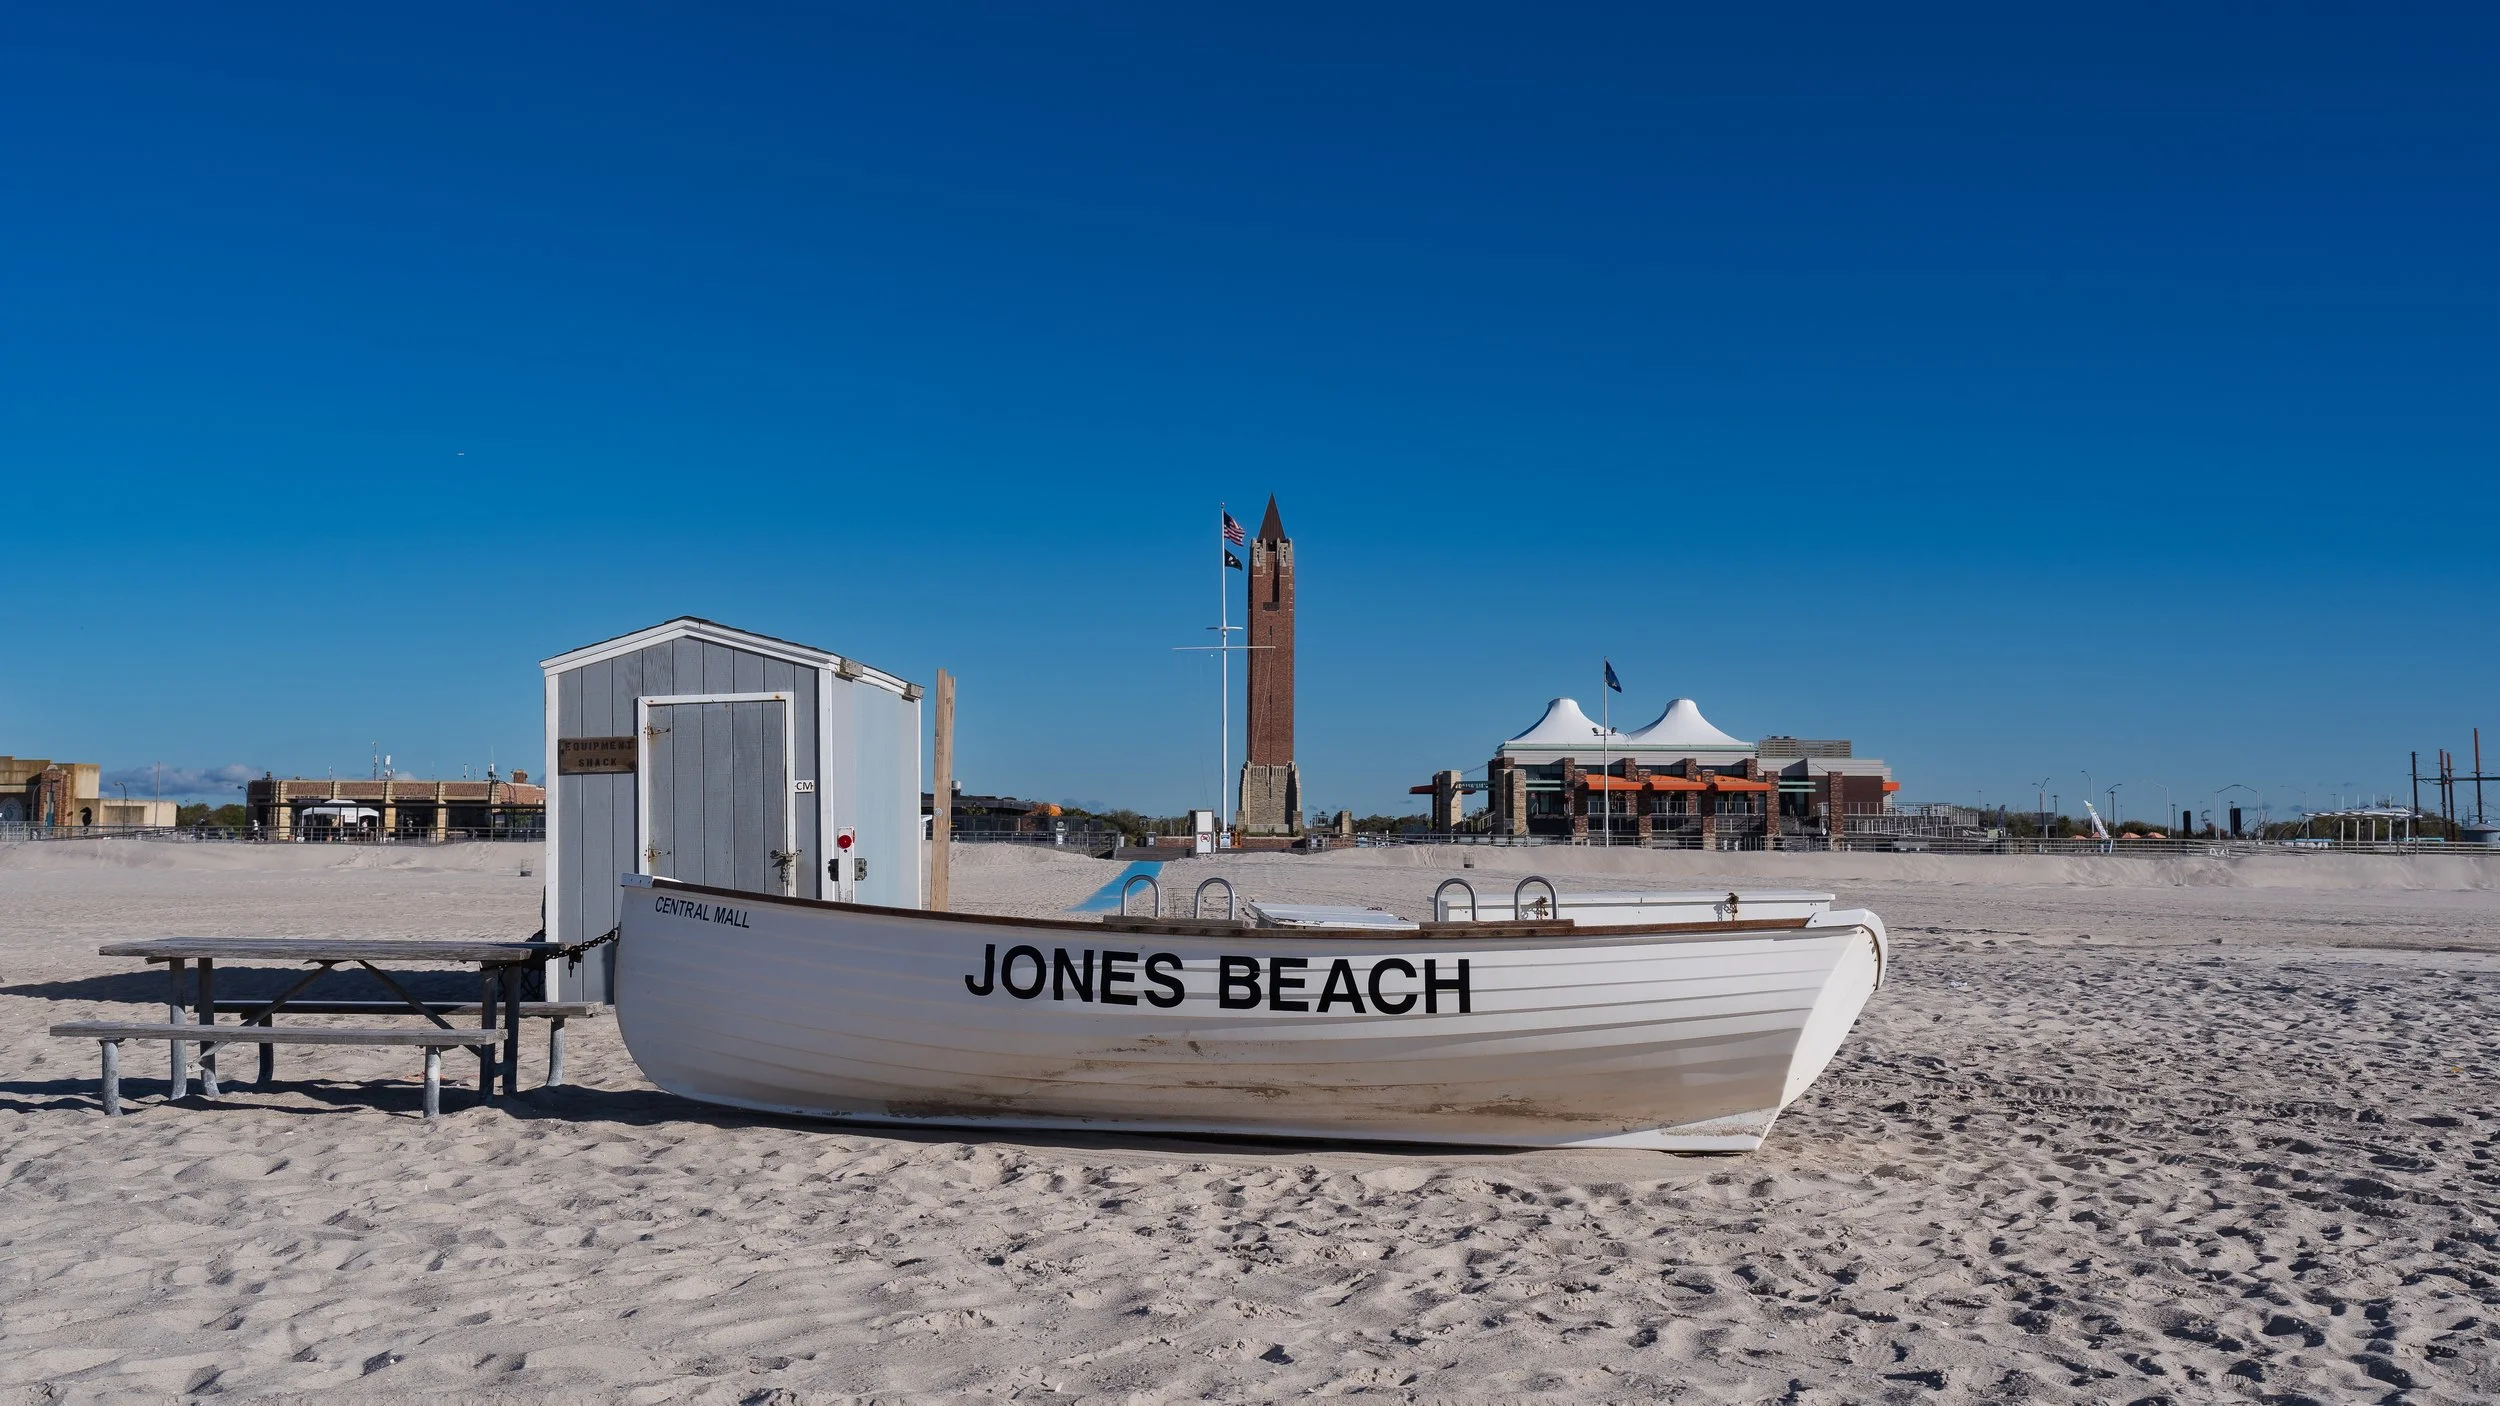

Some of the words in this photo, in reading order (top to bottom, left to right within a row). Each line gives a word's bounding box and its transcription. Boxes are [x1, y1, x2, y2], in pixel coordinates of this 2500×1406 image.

[564, 740, 633, 752] EQUIPMENT
[578, 757, 617, 768] SHACK
[655, 896, 709, 921] CENTRAL
[714, 906, 750, 928] MALL
[964, 943, 1186, 1008] JONES
[1218, 955, 1472, 1014] BEACH
